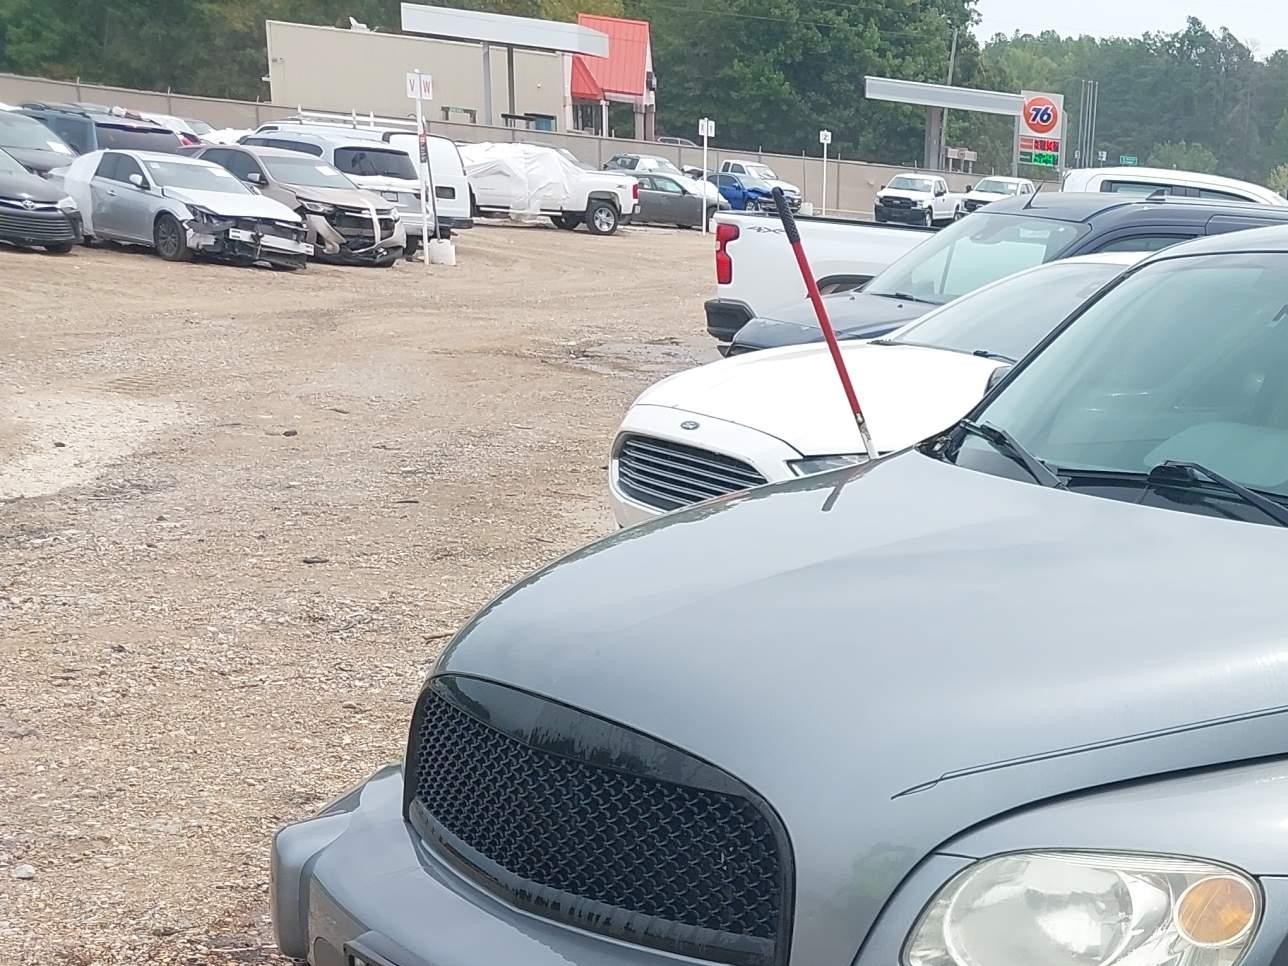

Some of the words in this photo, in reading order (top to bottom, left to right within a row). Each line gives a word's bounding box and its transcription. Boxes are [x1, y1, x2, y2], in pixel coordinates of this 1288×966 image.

[409, 79, 415, 92] V
[422, 79, 431, 94] W
[1029, 105, 1053, 125] 76
[746, 225, 786, 235] 4X
